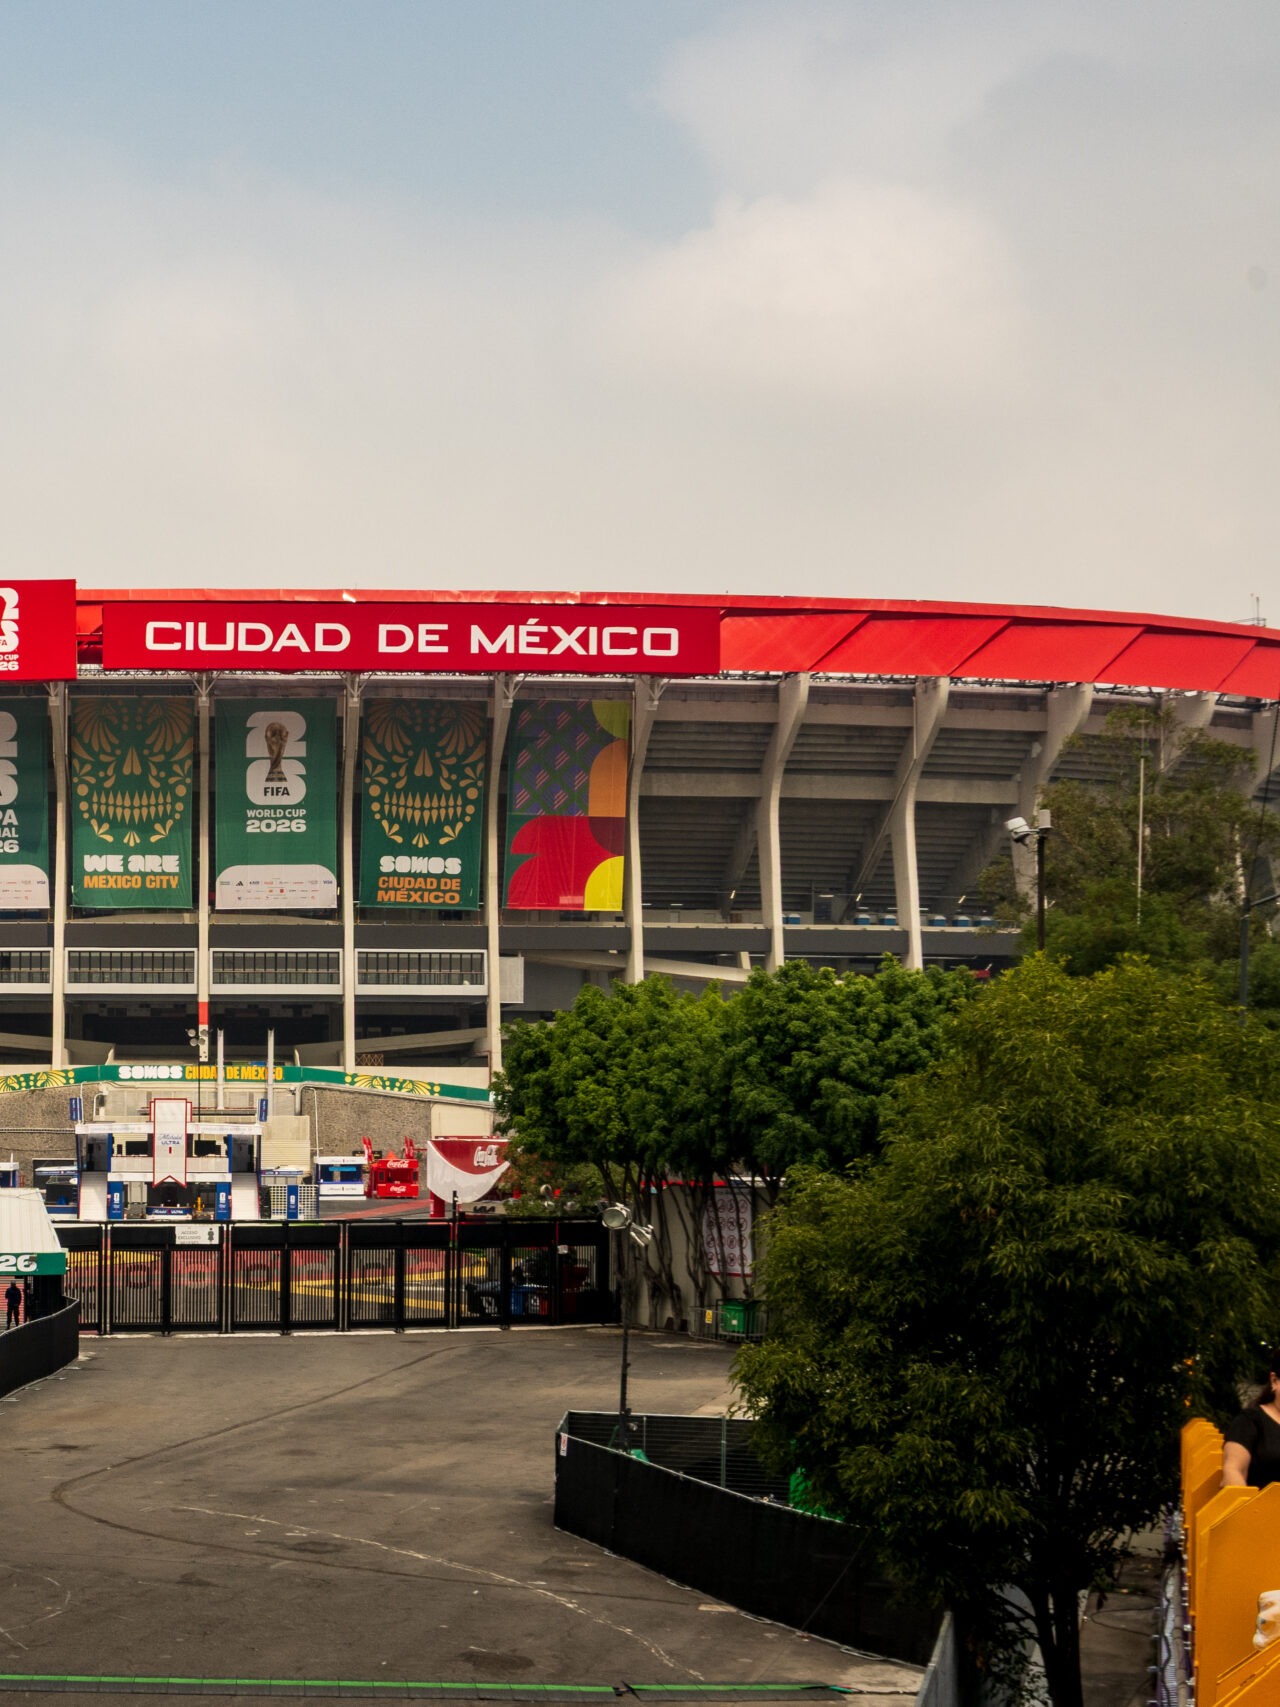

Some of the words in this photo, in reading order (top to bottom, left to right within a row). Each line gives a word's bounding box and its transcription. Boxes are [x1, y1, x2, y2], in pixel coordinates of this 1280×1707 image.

[145, 621, 351, 653] CIUDAD
[378, 624, 448, 653] DE
[470, 617, 679, 657] MÉXICO
[263, 786, 290, 797] FIFA
[246, 809, 284, 818] WORLD
[285, 809, 306, 818] CUP
[246, 819, 307, 833] 2026
[83, 854, 124, 873] WE
[379, 855, 462, 875] SOMOS
[83, 875, 142, 889] MEXICO
[145, 875, 179, 889] CITY
[378, 876, 438, 890] CIUDAD
[440, 878, 462, 891] DE
[376, 888, 460, 905] MÉXICO
[118, 1065, 183, 1080] SOMOS
[226, 1066, 239, 1080] DE
